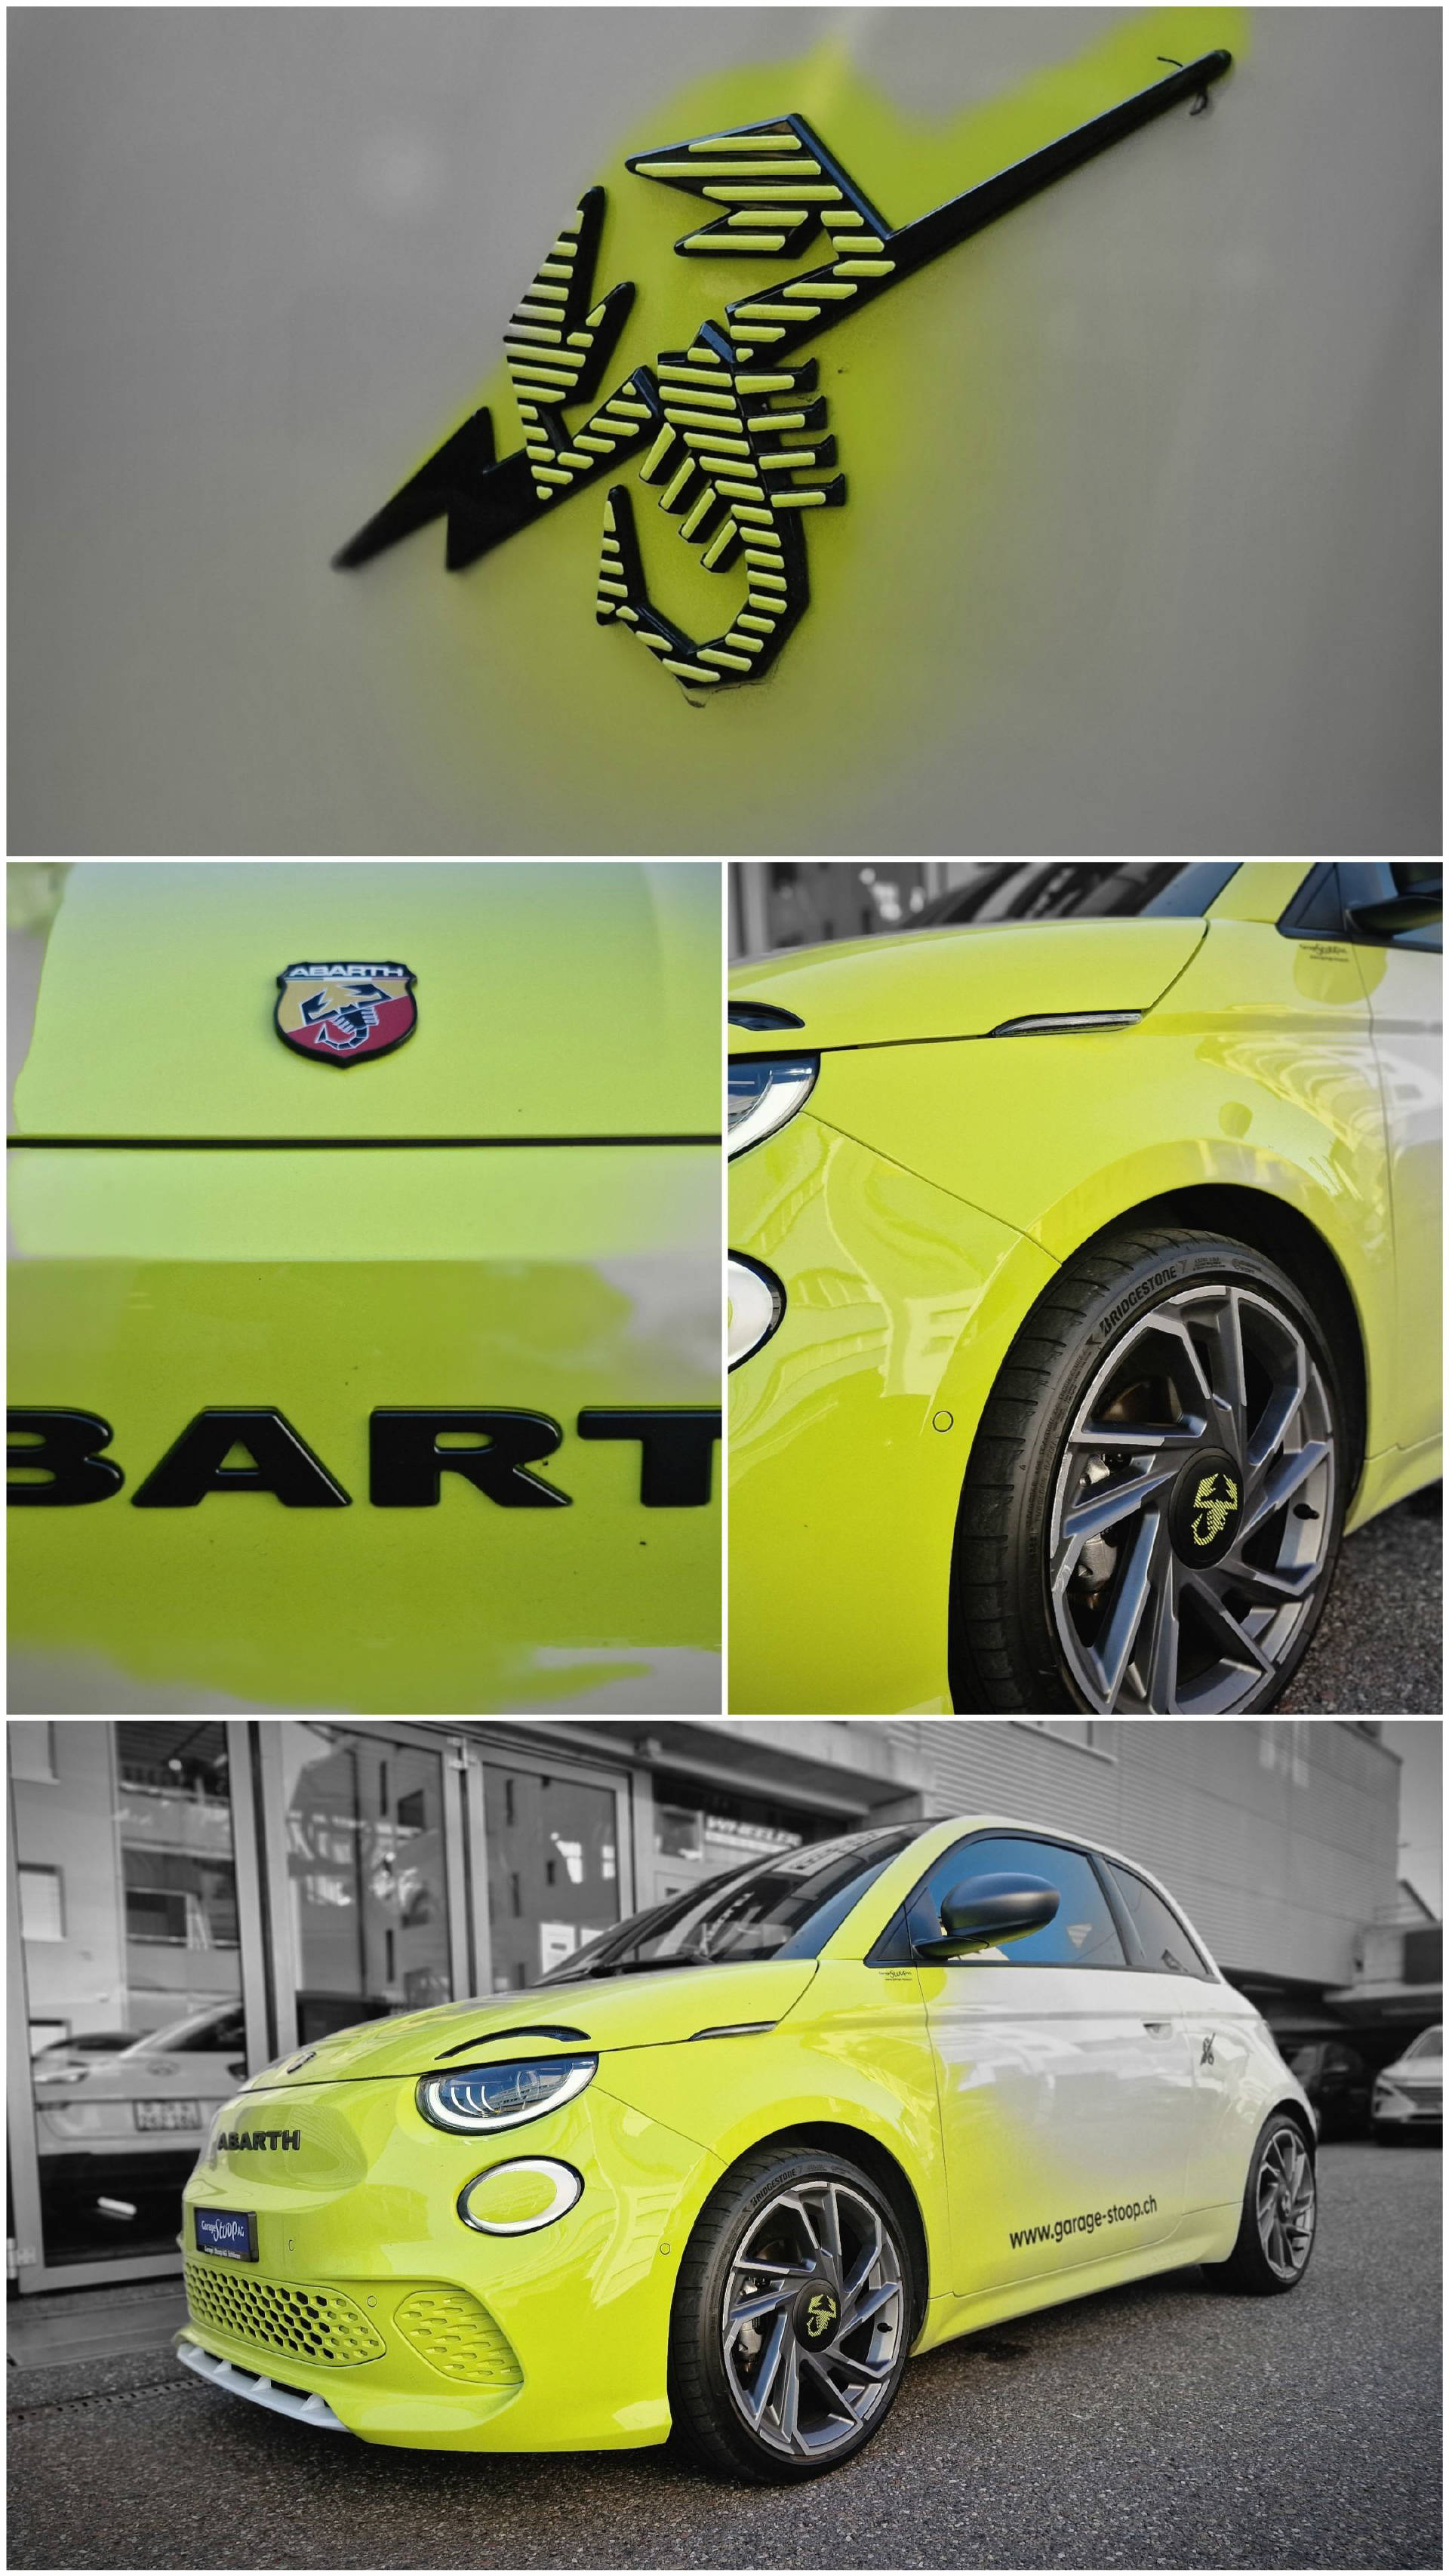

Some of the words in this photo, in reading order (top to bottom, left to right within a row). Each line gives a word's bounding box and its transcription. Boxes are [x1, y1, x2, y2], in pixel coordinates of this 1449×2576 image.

[289, 965, 404, 977] ABARTH
[1100, 1265, 1177, 1337] BRIDGESTONE
[217, 2130, 300, 2151] ABARTH
[750, 2168, 796, 2208] BRIDGESTONE
[213, 2218, 238, 2242] Stoop
[237, 2226, 245, 2237] AG
[1009, 2194, 1158, 2249] www.garage-stoop.ch
